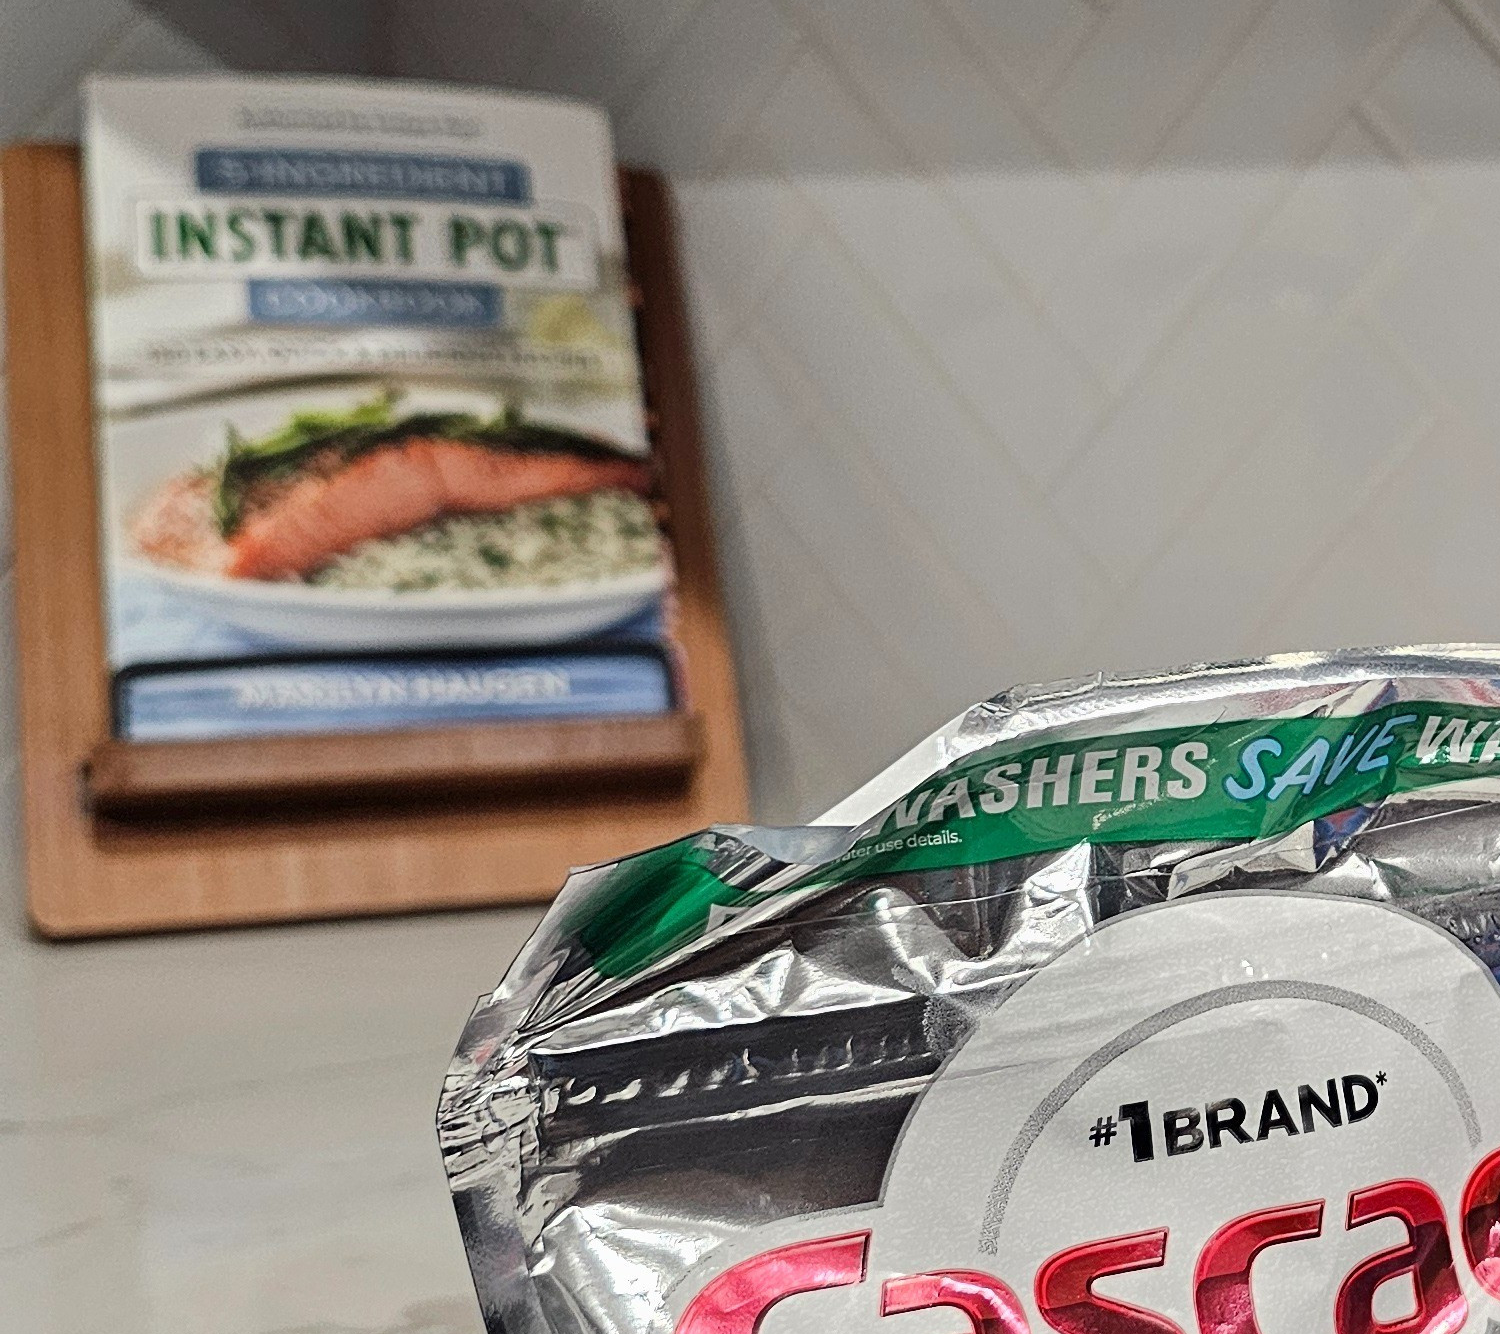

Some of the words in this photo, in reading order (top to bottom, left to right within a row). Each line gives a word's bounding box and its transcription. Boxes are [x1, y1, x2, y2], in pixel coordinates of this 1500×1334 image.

[150, 207, 419, 268] INSTANT
[448, 215, 566, 274] POT
[1223, 713, 1417, 802] SAVE
[832, 843, 874, 863] ater
[875, 838, 904, 854] use
[906, 830, 963, 849] details.
